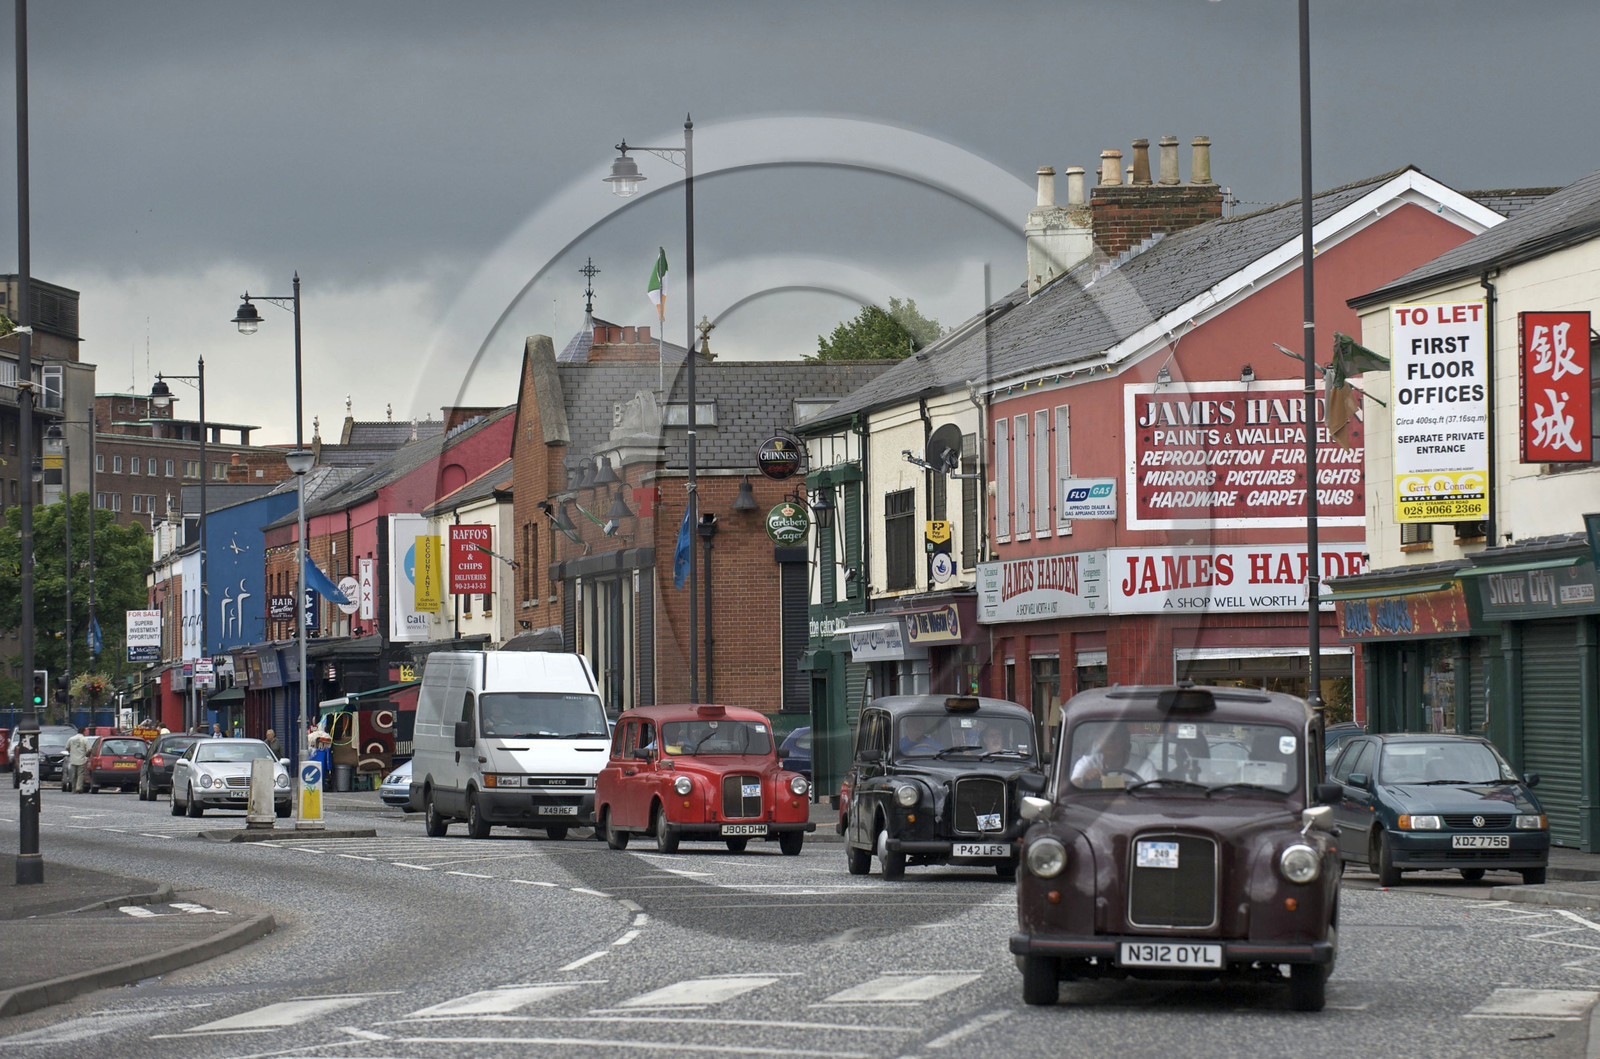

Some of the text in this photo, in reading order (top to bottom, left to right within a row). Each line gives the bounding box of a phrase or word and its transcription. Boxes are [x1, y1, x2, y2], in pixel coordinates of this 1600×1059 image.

[1395, 304, 1483, 326] TO LET
[1411, 335, 1470, 355] FIRST
[1407, 360, 1475, 380] FLOOR
[1398, 384, 1484, 405] OFFICES
[1139, 398, 1236, 428] JAMES
[1395, 413, 1487, 426] Circa 400sq.ft (37.16sq.m)
[1153, 429, 1220, 447] PAINTS
[1223, 433, 1233, 445] &
[1397, 431, 1485, 444] SEPARATE PRIVATE
[760, 450, 798, 461] GUINNESS
[1416, 444, 1466, 454] ENTRANCE
[1140, 447, 1364, 467] REPRODUCTION FURITURE
[1143, 468, 1361, 487] MIRRORS PICTURES IGHTS
[1070, 486, 1111, 499] FLO GAS
[1408, 482, 1431, 493] Gerry
[1443, 481, 1474, 491] Connor
[1149, 490, 1239, 508] HARDWARE
[1404, 504, 1482, 516] 028 9066 2366
[769, 516, 807, 529] Carlsberg
[452, 530, 488, 540] RAFFO'S
[776, 532, 803, 542] Lager
[458, 562, 483, 570] CHIPS
[1001, 555, 1079, 602] JAMES HARDEN
[1121, 554, 1235, 597] JAMES
[362, 564, 371, 615] TAXI
[1488, 569, 1557, 608] Silver City
[272, 598, 293, 606] HAIR
[1020, 605, 1028, 616] SHOP
[1036, 602, 1047, 614] WORTH
[1163, 600, 1174, 609] A
[1178, 598, 1211, 608] SHOP
[1214, 596, 1246, 608] WELL
[1250, 595, 1297, 606] WORTH
[406, 614, 426, 624] Call
[918, 614, 930, 634] THE
[1455, 836, 1508, 846] XDZ 7756
[960, 846, 1003, 856] P42 LFS
[1154, 849, 1170, 858] 249
[1128, 945, 1215, 962] N312 OYL
